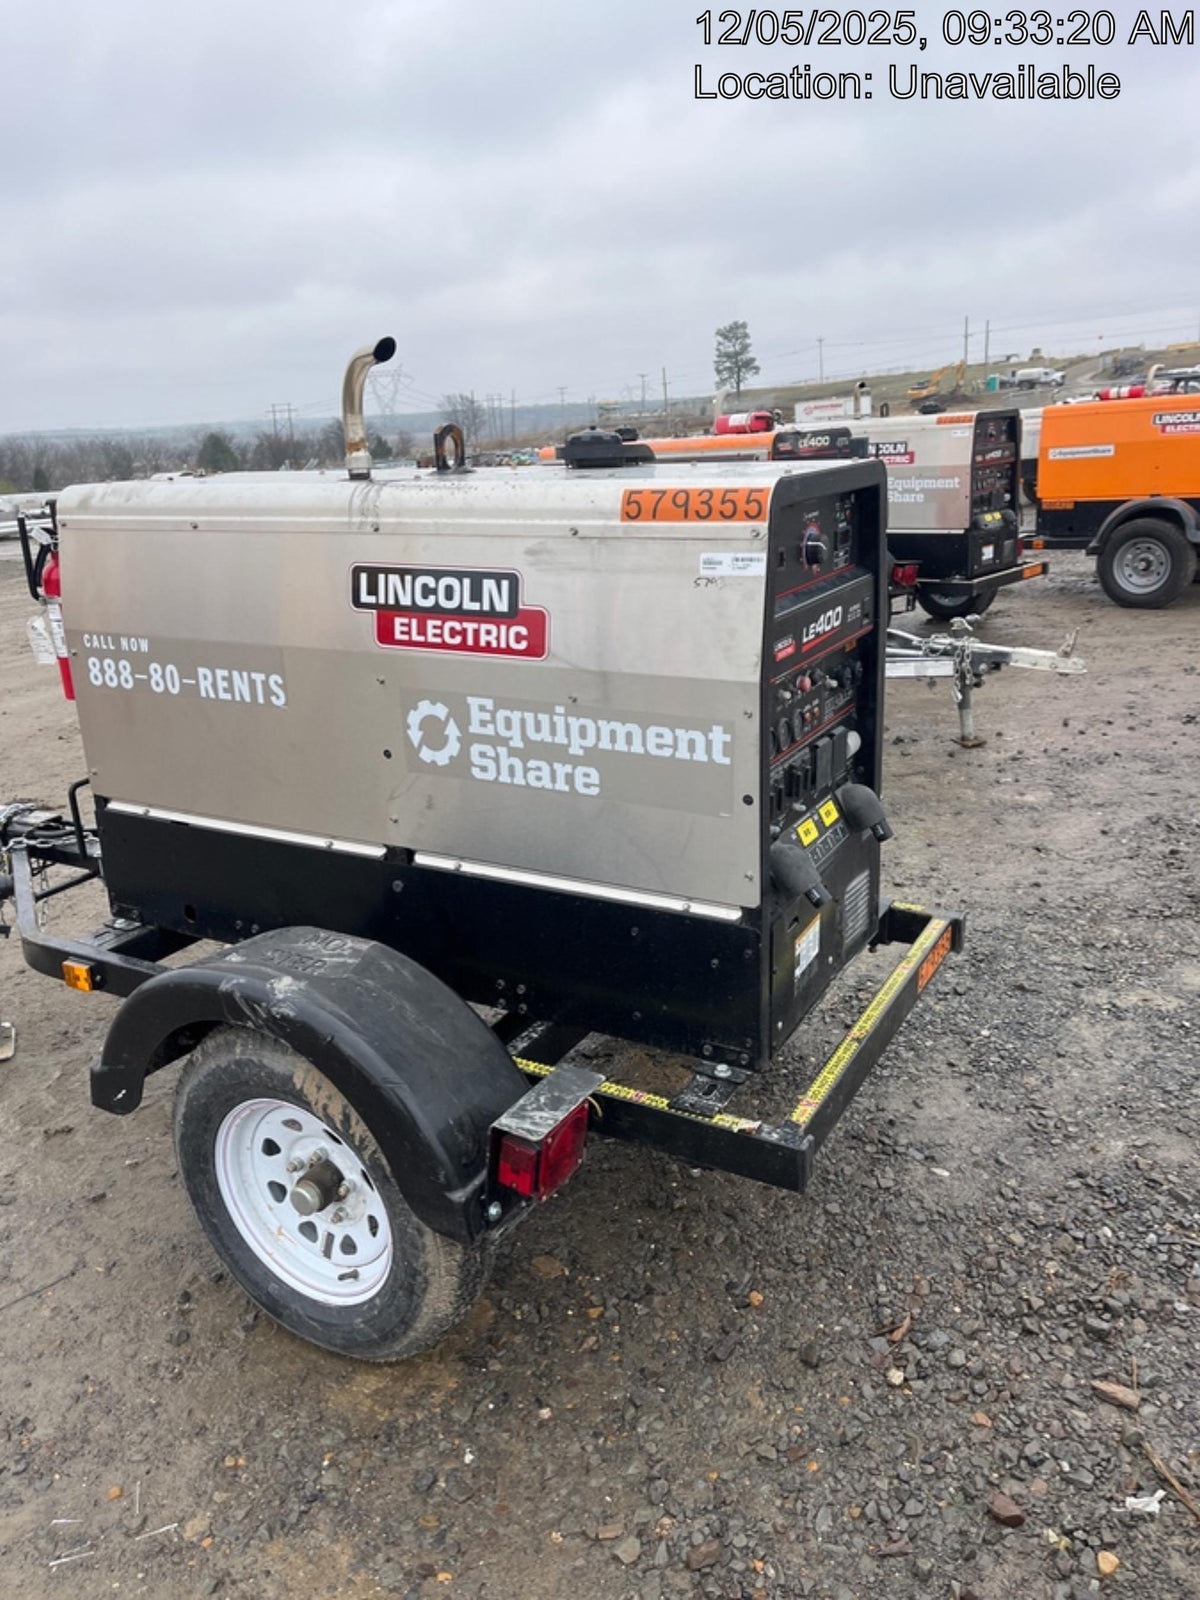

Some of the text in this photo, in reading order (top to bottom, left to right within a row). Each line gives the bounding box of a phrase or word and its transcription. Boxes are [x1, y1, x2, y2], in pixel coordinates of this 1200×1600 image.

[625, 489, 765, 520] 579355
[359, 572, 509, 612] LINCOLN
[83, 633, 149, 653] CALL NOW
[393, 617, 528, 650] ELECTRIC
[87, 656, 286, 707] 888-80-RENTS
[466, 696, 732, 765] Equipment
[467, 743, 600, 796] Share
